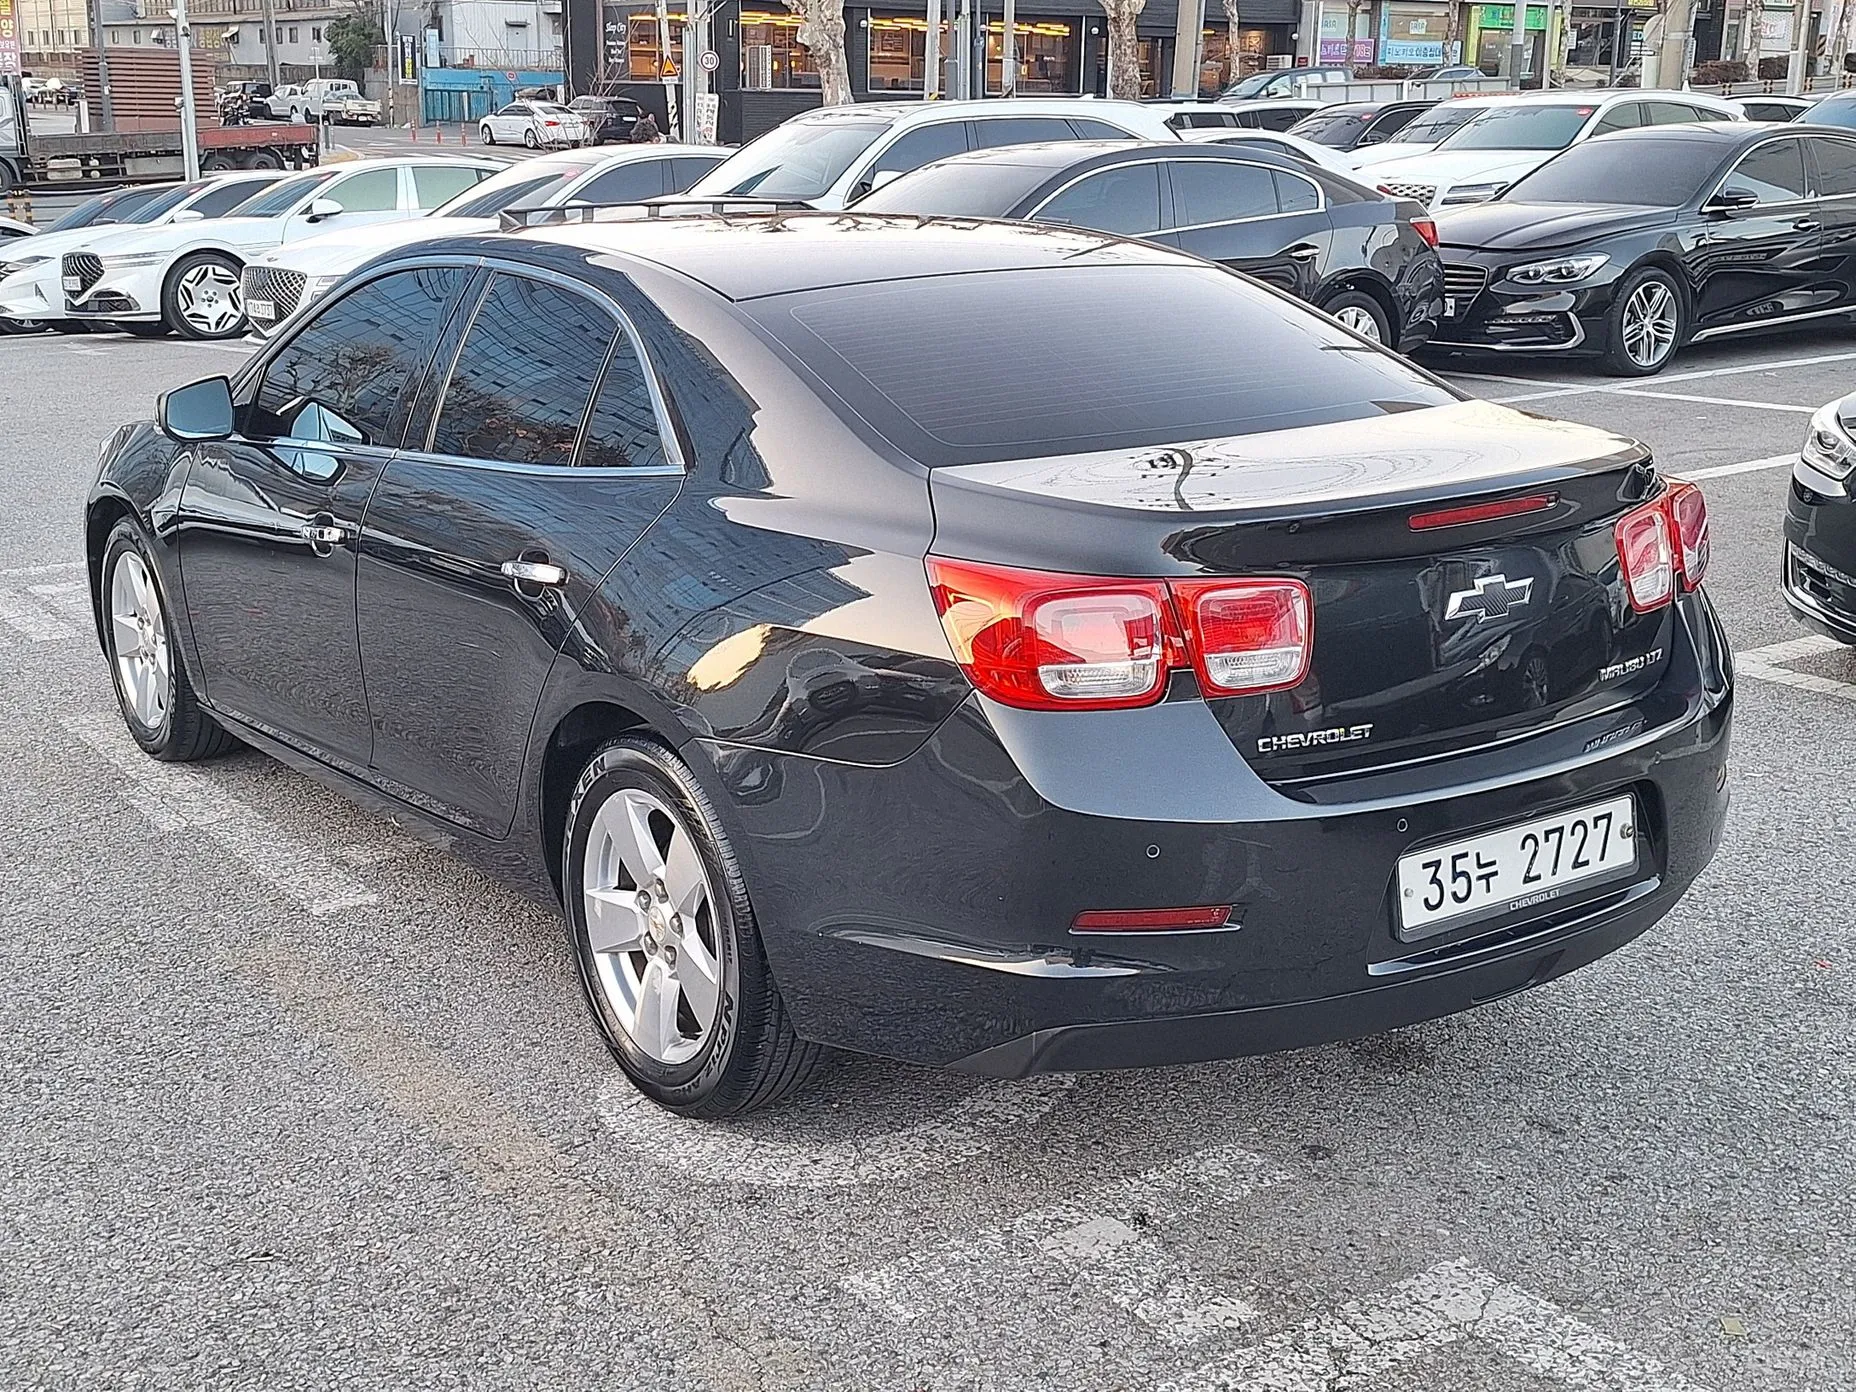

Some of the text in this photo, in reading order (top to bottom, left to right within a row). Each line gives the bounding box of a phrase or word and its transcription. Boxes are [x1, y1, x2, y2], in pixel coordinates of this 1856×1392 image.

[704, 56, 715, 66] 30
[1257, 723, 1374, 753] CHEVROLET
[1421, 811, 1613, 912] 35누 2727
[1509, 889, 1561, 911] CHEVROLET
